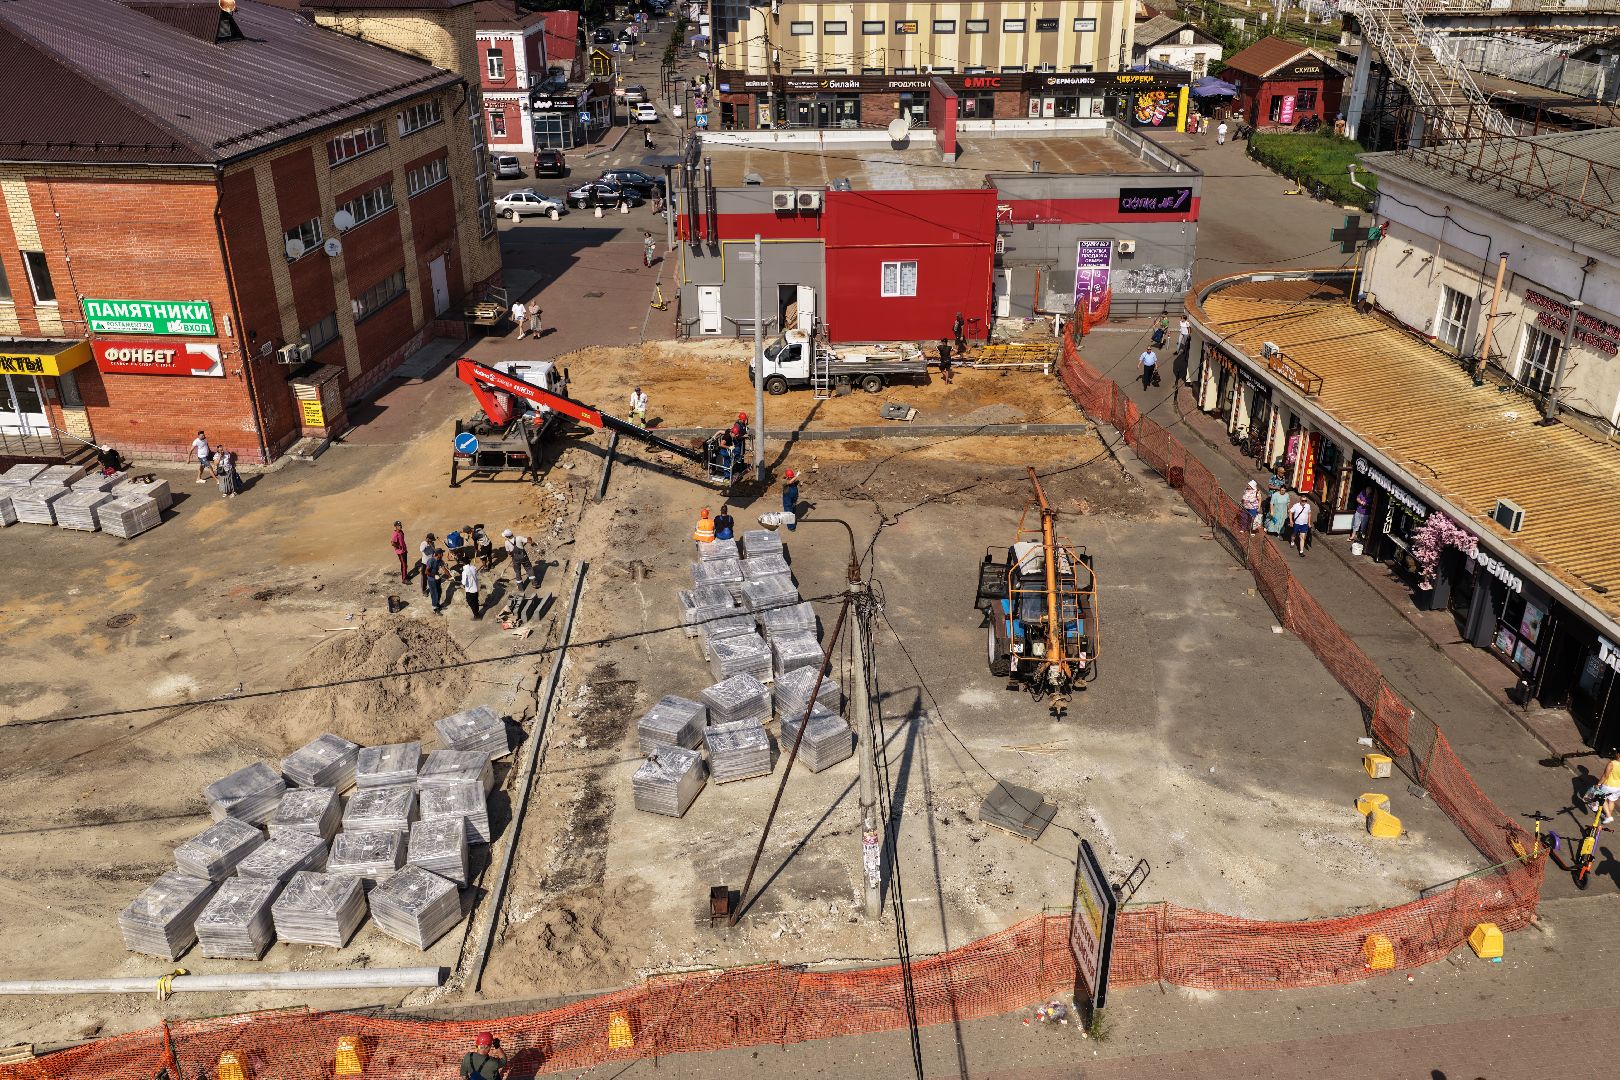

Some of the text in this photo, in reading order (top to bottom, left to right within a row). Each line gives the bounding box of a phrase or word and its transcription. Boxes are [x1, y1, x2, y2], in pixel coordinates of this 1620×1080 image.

[973, 77, 1000, 88] МТС
[1056, 77, 1095, 85] ЕРМОЛИНО
[1116, 75, 1154, 83] ЧЕБУРЕКИ
[829, 80, 860, 89] билайн
[87, 302, 209, 320] ПАМЯТНИКИ
[183, 323, 208, 332] ВХОД
[104, 347, 176, 364] ФОНБЕТ
[1467, 547, 1522, 593] ОФЕЙНЯ
